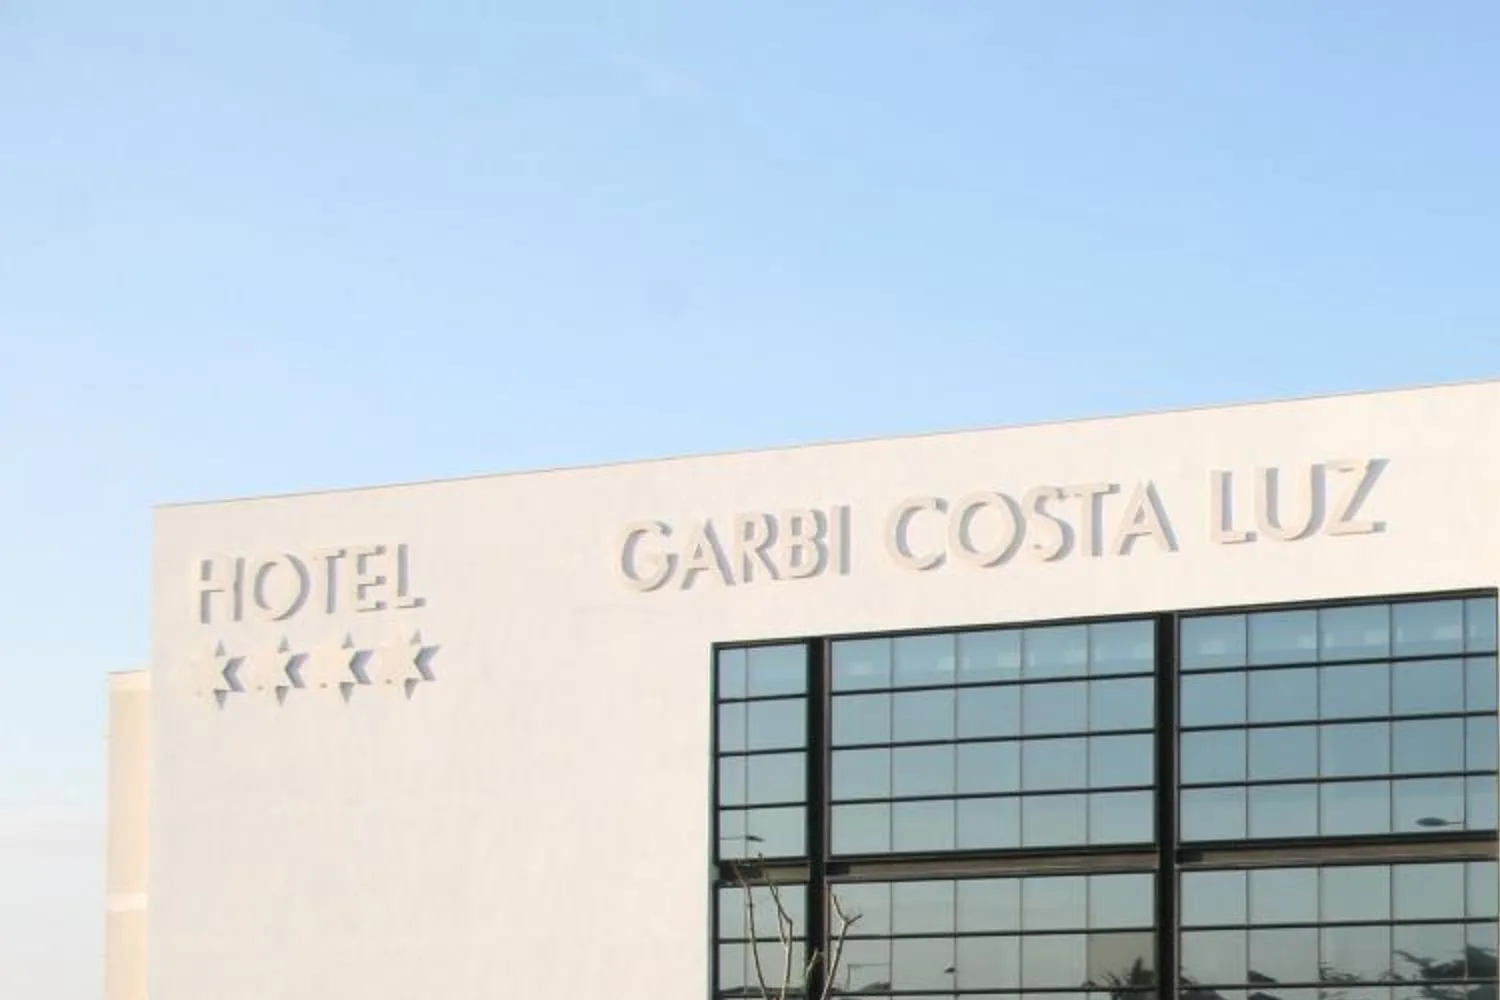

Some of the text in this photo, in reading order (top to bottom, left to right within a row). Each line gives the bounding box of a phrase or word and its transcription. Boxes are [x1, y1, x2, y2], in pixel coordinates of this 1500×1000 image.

[197, 457, 1390, 625] HOTEL GARBI COSTA LUZ
